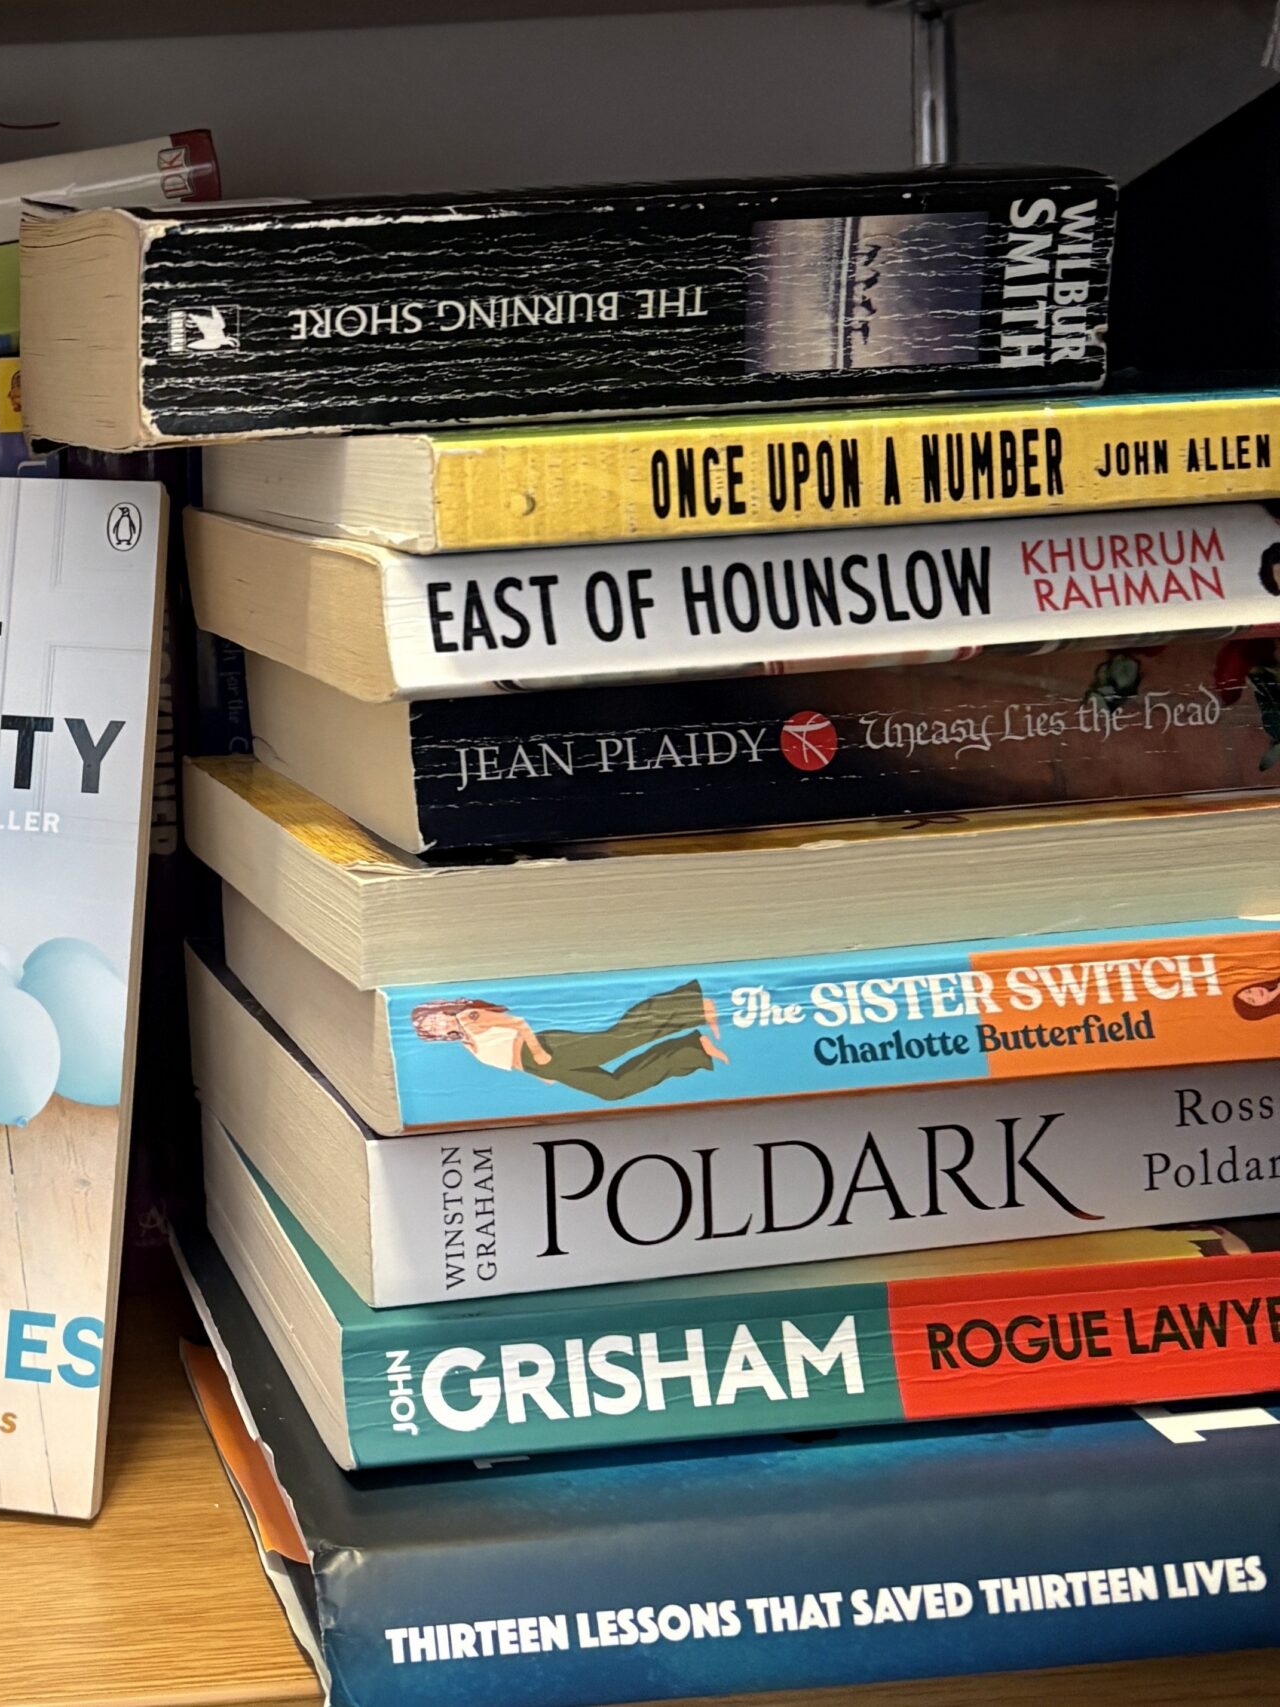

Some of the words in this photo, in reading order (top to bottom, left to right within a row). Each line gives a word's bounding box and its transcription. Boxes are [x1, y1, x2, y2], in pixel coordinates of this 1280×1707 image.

[437, 291, 619, 333] BURNING
[637, 286, 709, 319] THE
[1000, 198, 1057, 368] SMITH
[1051, 198, 1098, 364] WILBUR
[289, 302, 424, 341] SHORE
[651, 444, 745, 519] ONCE
[768, 438, 860, 510] UPON
[884, 436, 901, 505] A
[922, 426, 1064, 502] NUMBER
[1095, 439, 1168, 478] JOHN
[1186, 434, 1272, 472] ALLEN
[1021, 528, 1225, 575] KHURRUM
[426, 574, 558, 653] EAST
[586, 568, 654, 643] OF
[682, 545, 991, 637] HOUNSLOW
[1034, 566, 1225, 613] RAHMAN
[857, 711, 993, 760] Uneasy
[1002, 705, 1067, 745] Lies
[1076, 702, 1123, 735] the
[1142, 686, 1224, 729] Head
[455, 741, 573, 791] JEAN
[598, 727, 766, 773] PLAIDY
[732, 986, 806, 1029] The
[813, 970, 1002, 1028] SISTER
[1006, 953, 1222, 1012] SWITCH
[813, 1028, 969, 1067] Charlotte
[976, 1010, 1155, 1054] Butterfield
[1174, 1087, 1273, 1127] Ross
[532, 1110, 1105, 1258] POLDARK
[1142, 1145, 1280, 1191] Poldar
[441, 1146, 465, 1290] WINSTON
[473, 1146, 497, 1281] GRAHAM
[927, 1308, 1112, 1371] ROGUE
[386, 1350, 419, 1436] JOHN
[421, 1314, 864, 1432] GRISHAM
[385, 1615, 569, 1665] THIRTEEN
[577, 1598, 741, 1650] LESSONS
[746, 1590, 843, 1635] THAT
[850, 1582, 972, 1627] SAVED
[977, 1570, 1157, 1620] THIRTEEN
[1164, 1556, 1267, 1599] LIVES
